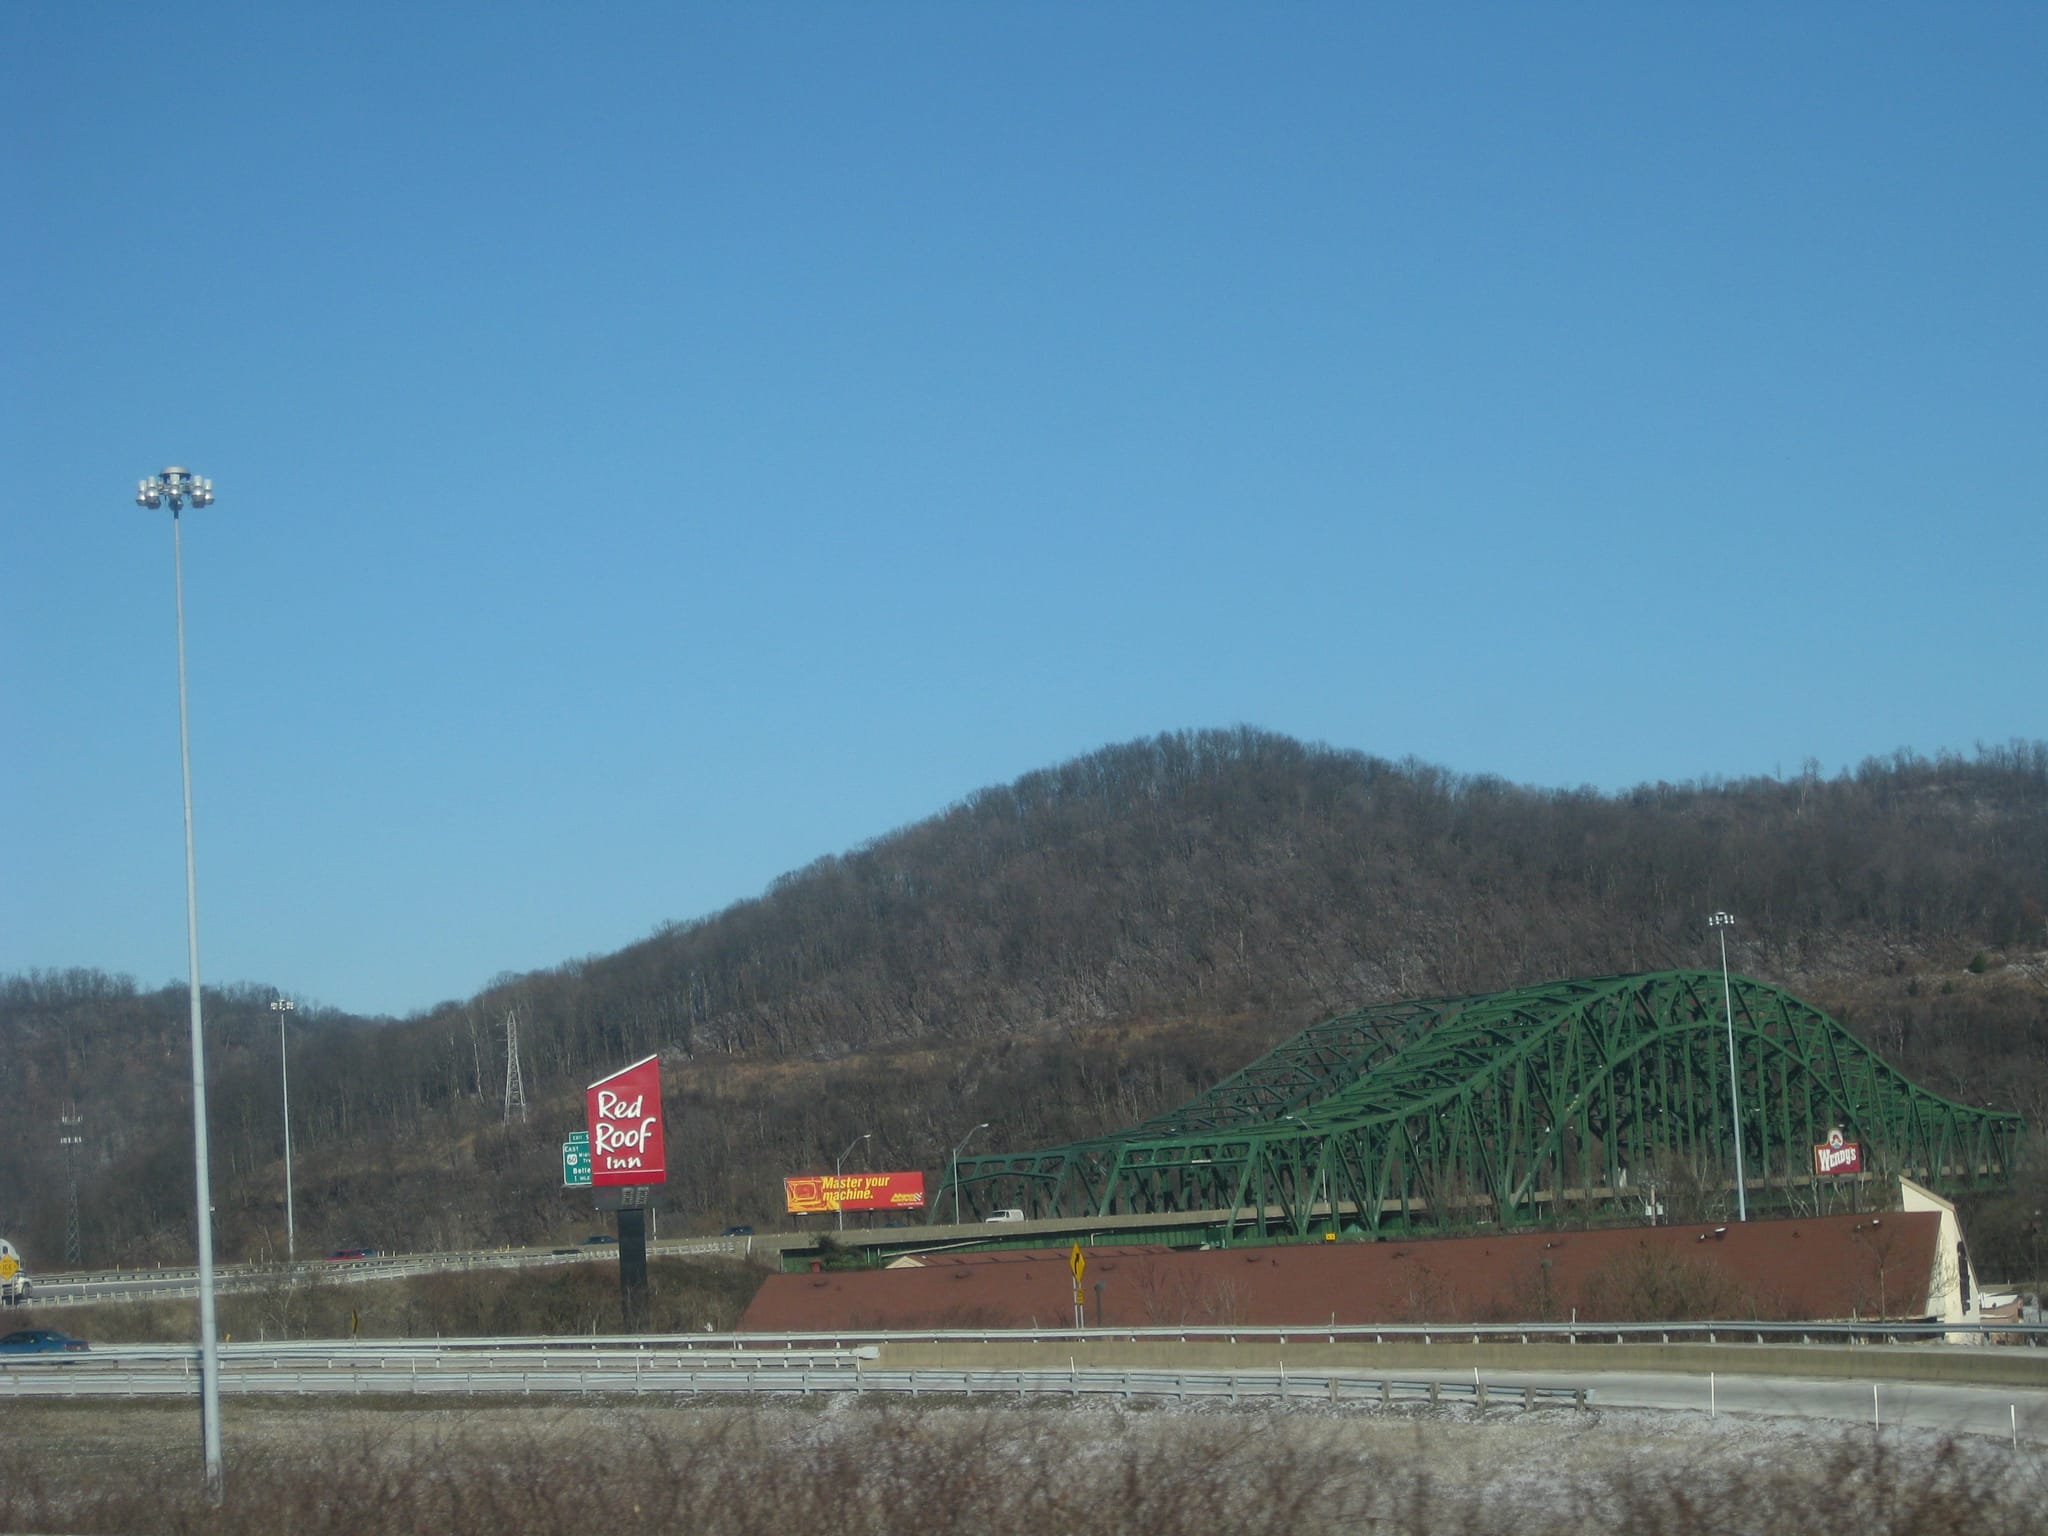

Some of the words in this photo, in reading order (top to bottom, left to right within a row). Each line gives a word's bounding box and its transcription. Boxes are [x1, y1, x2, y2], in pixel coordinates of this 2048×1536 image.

[598, 1091, 643, 1120] Red
[595, 1117, 656, 1155] Roof
[606, 1156, 642, 1170] Inn
[822, 1177, 863, 1189] Master
[866, 1176, 890, 1191] your
[823, 1189, 874, 1201] machine.
